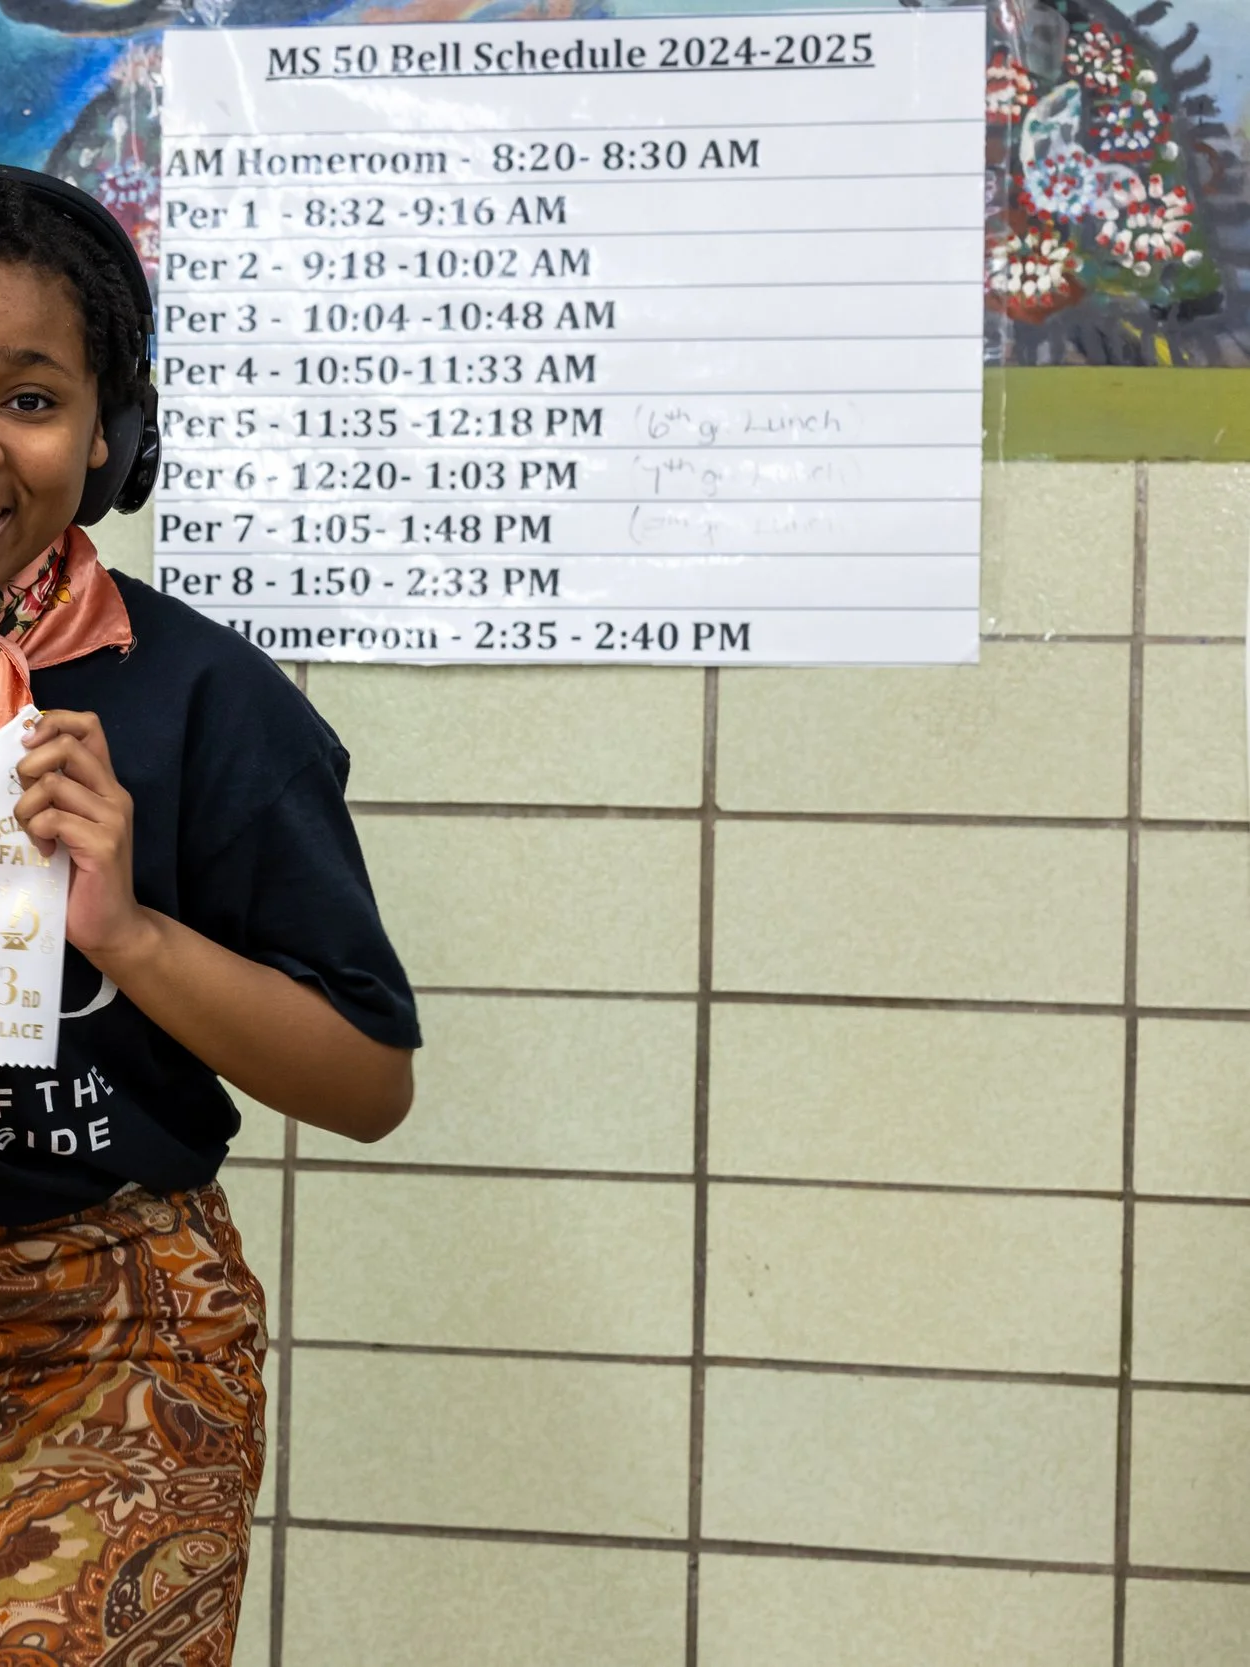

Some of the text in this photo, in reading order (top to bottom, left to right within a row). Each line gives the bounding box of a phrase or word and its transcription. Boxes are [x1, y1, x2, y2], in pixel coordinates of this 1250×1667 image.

[268, 31, 874, 76] MS 50 Bell Schedule 2024-2025
[166, 148, 223, 177] AM
[238, 148, 446, 176] Homeroom
[603, 141, 687, 170] 8:30
[699, 139, 759, 168] AM
[167, 201, 228, 229] Per
[245, 200, 256, 228] 1
[305, 198, 384, 227] 8:32
[507, 196, 566, 224] AM
[166, 253, 227, 281] Per
[239, 252, 258, 279] 2
[303, 251, 385, 280] 9:18
[531, 248, 590, 277] AM
[165, 305, 226, 333] Per
[238, 304, 257, 332] 3
[305, 304, 410, 332] 10:04
[555, 301, 615, 330] AM
[164, 357, 226, 385] Per
[236, 357, 258, 384] 4
[536, 354, 596, 383] AM
[163, 408, 225, 439] Per
[236, 409, 256, 438] 5
[297, 408, 397, 437] 11:35
[546, 408, 603, 437] PM
[160, 460, 223, 491] Per
[235, 462, 255, 490] 6
[428, 461, 505, 490] 1:03
[520, 461, 577, 490] PM
[160, 514, 222, 542] Per
[234, 514, 254, 542] 7
[401, 515, 481, 543] 1:48
[495, 514, 551, 543] PM
[158, 566, 222, 597] Per
[232, 567, 253, 595] 8
[291, 567, 371, 596] 1:50
[407, 567, 488, 597] 2:33
[504, 568, 560, 597] PM
[475, 621, 557, 650] 2:35
[595, 622, 678, 651] 2:40
[693, 622, 750, 651] PM
[35, 1065, 114, 1113] THE
